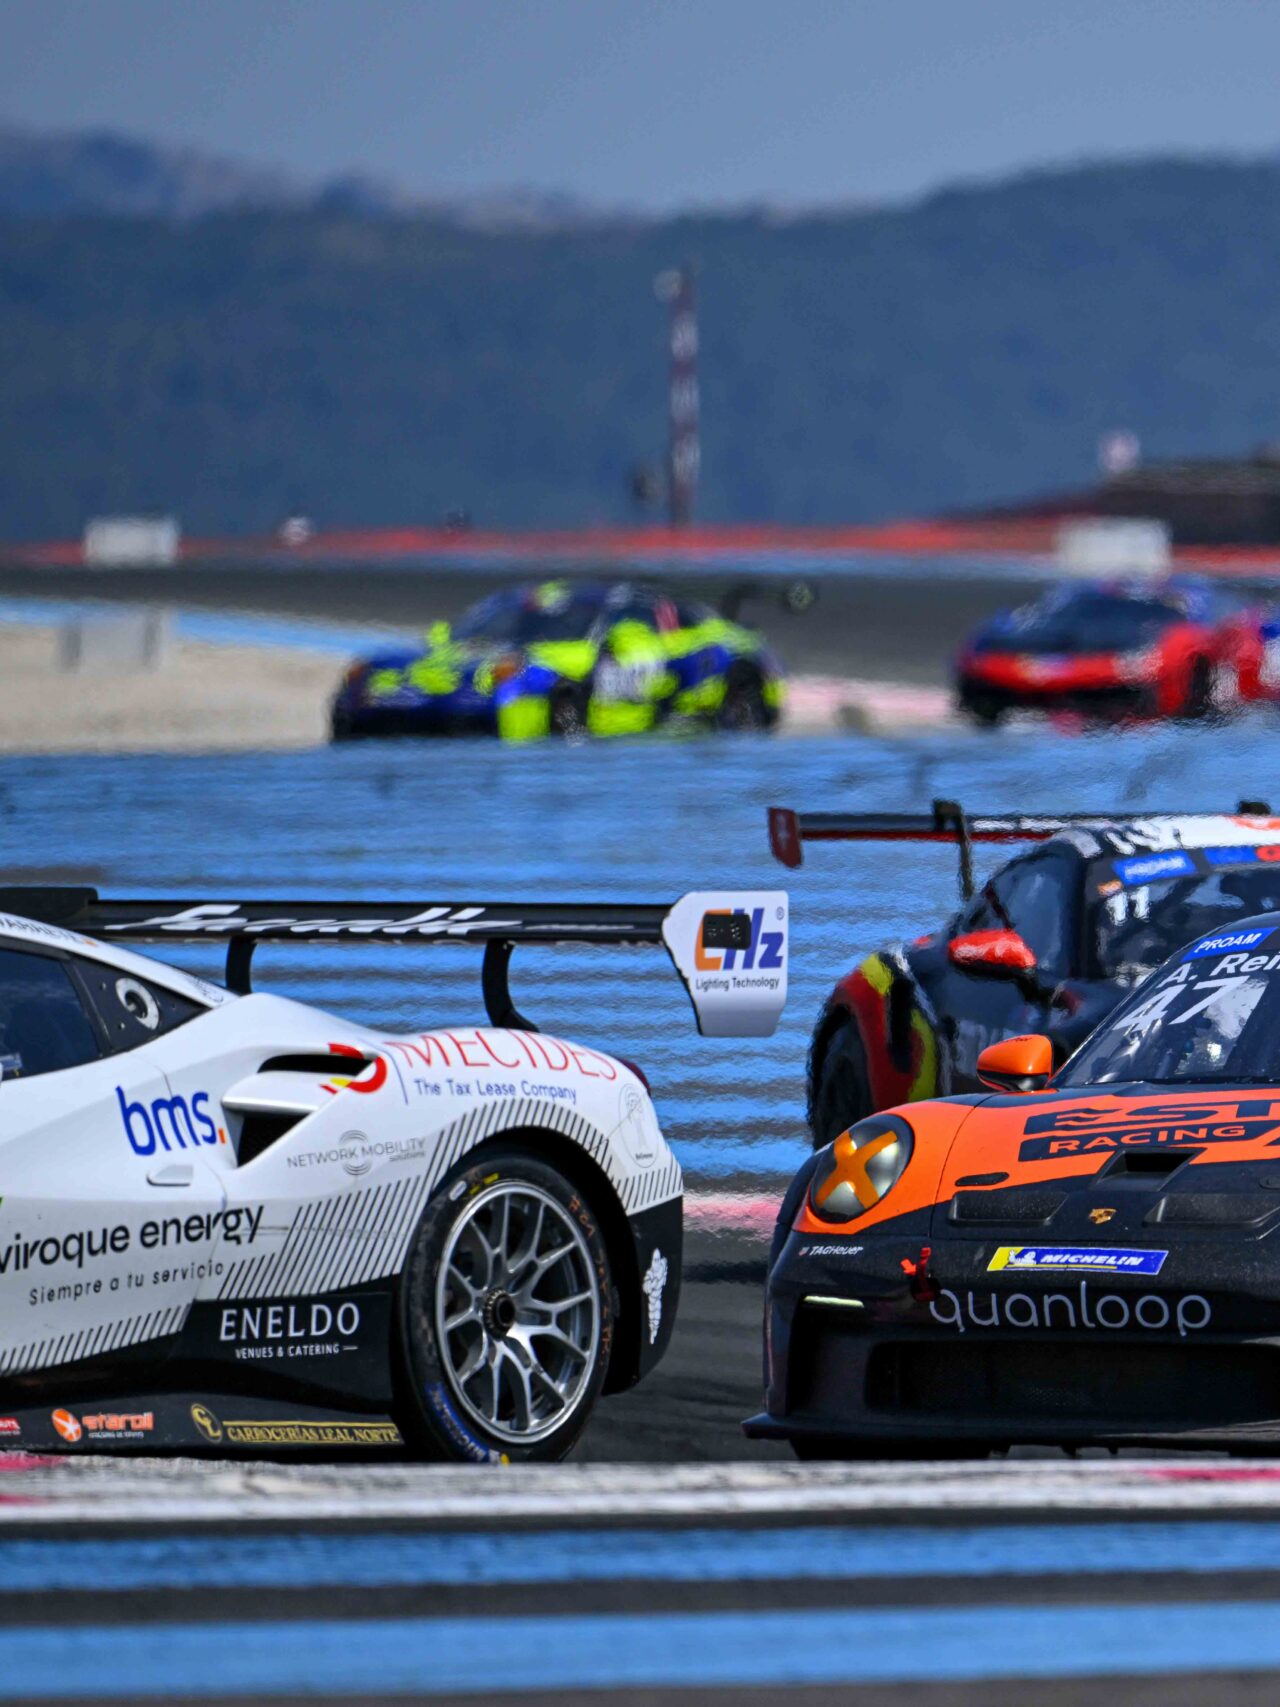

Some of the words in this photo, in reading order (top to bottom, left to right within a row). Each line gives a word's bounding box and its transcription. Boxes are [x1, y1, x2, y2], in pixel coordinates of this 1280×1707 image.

[1194, 932, 1262, 953] PROAM
[695, 978, 729, 992] Lighting
[732, 977, 779, 990] Technology
[1112, 975, 1250, 1033] 47
[384, 1029, 618, 1082] MECIDES
[414, 1079, 441, 1095] The
[447, 1080, 471, 1096] Tax
[477, 1080, 517, 1098] Lease
[520, 1080, 577, 1106] Company
[287, 1149, 360, 1169] NETWORK
[361, 1138, 427, 1157] MOBILITY
[1048, 1125, 1246, 1154] RACING
[139, 1205, 264, 1250] energy
[1040, 1254, 1145, 1266] MICHELIN
[29, 1280, 103, 1306] Siempre
[127, 1271, 145, 1290] tu
[152, 1259, 225, 1286] servicio
[219, 1302, 361, 1341] ENELDO
[929, 1281, 1211, 1336] quanloop
[235, 1347, 274, 1360] VENUES
[287, 1344, 340, 1357] CATERING
[319, 1427, 355, 1442] LEAL
[352, 1428, 401, 1442] NORTE
